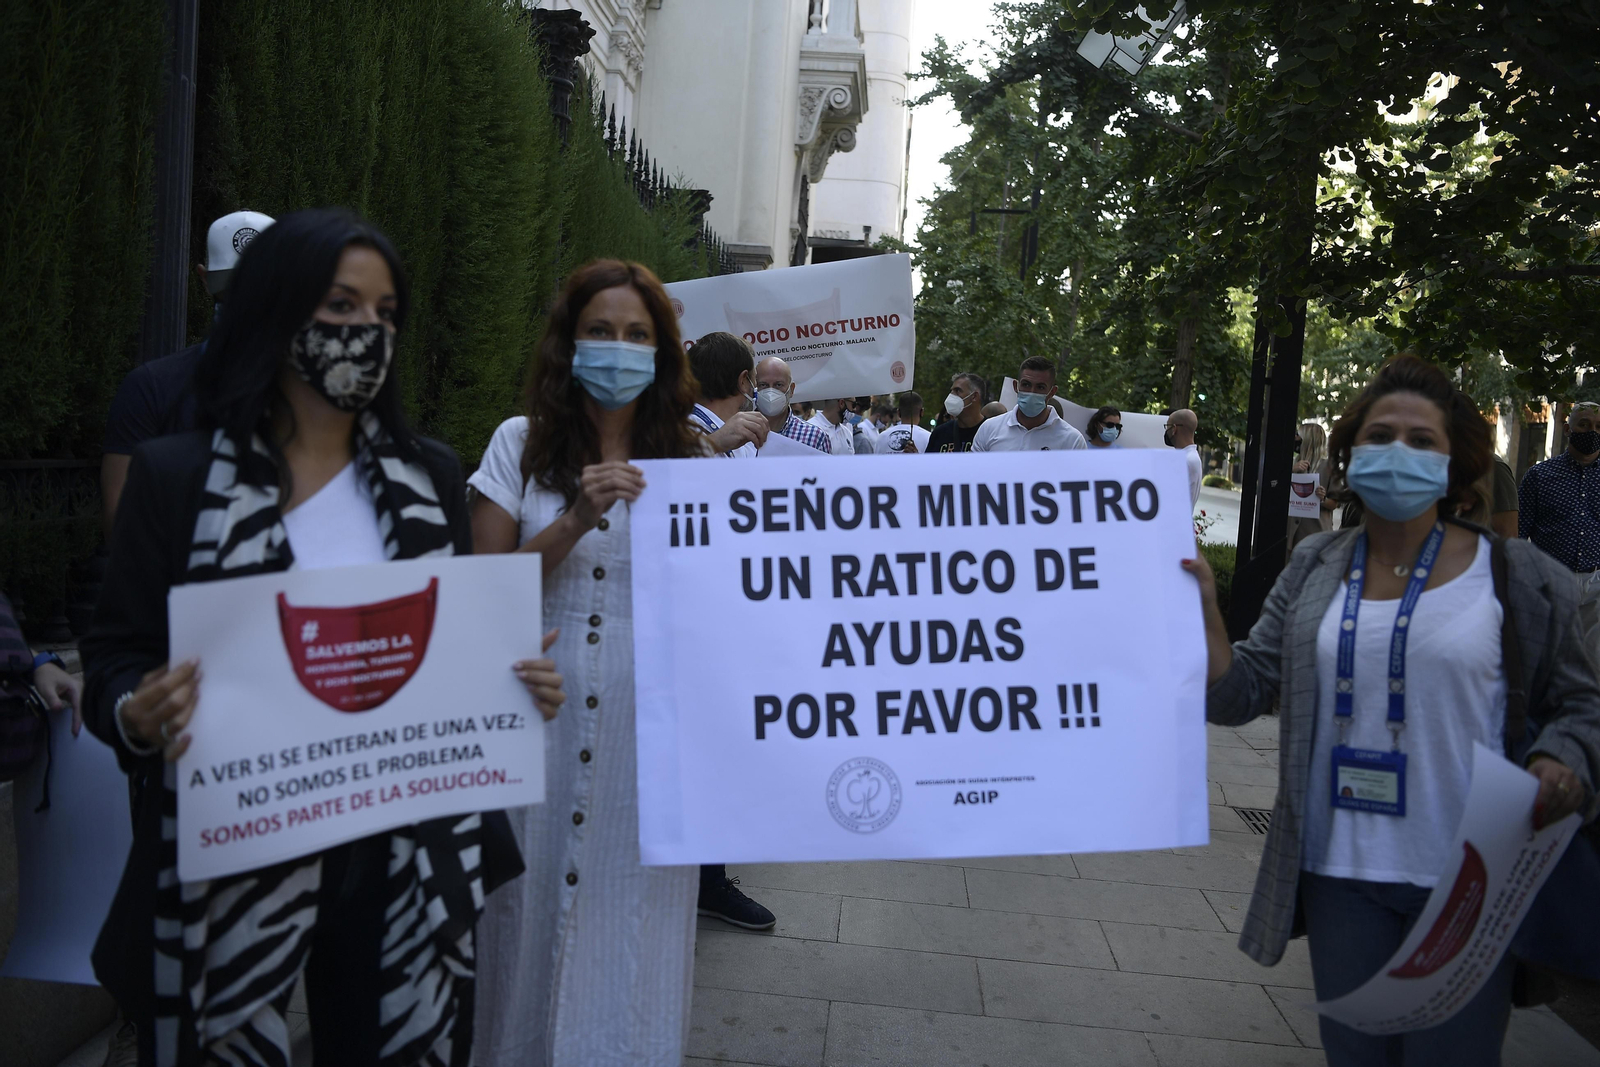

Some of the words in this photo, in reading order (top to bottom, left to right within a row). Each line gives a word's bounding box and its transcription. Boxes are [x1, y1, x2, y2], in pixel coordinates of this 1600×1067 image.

[743, 327, 790, 345] OCIO
[796, 313, 901, 340] NOCTURNO
[756, 349, 776, 357] VIVEN
[777, 346, 790, 354] DEL
[790, 344, 807, 353] OCIO
[845, 335, 876, 346] MALAUVA
[728, 477, 901, 535] SEÑOR
[918, 478, 1161, 529] MINISTRO
[741, 556, 812, 602] UN
[832, 550, 1016, 599] RATICO
[1035, 547, 1099, 592] DE
[301, 620, 320, 643] #
[304, 637, 389, 660] SALVEMOS
[391, 633, 413, 649] LA
[821, 617, 1024, 668] AYUDAS
[754, 692, 859, 740] POR
[876, 686, 1042, 736] FAVOR
[1058, 683, 1102, 729] !!!
[189, 768, 207, 790] A
[211, 754, 253, 783] VER
[257, 748, 275, 773] SI
[280, 745, 303, 769] SE
[307, 727, 397, 762] ENTERAN
[403, 723, 429, 744] DE
[433, 716, 478, 739] UNA
[482, 711, 526, 733] VEZ:
[237, 783, 270, 810] NO
[275, 767, 347, 802] SOMOS
[352, 760, 373, 781] EL
[378, 742, 485, 776] PROBLEMA
[198, 812, 283, 848] SOMOS
[287, 801, 346, 828] PARTE
[350, 791, 375, 813] DE
[379, 783, 404, 804] LA
[407, 765, 524, 797] SOLUCIÓN...
[953, 789, 999, 805] AGIP
[1446, 912, 1495, 987] ENTERAN
[1505, 847, 1529, 884] UNA
[1488, 849, 1540, 937] PROBLEMA
